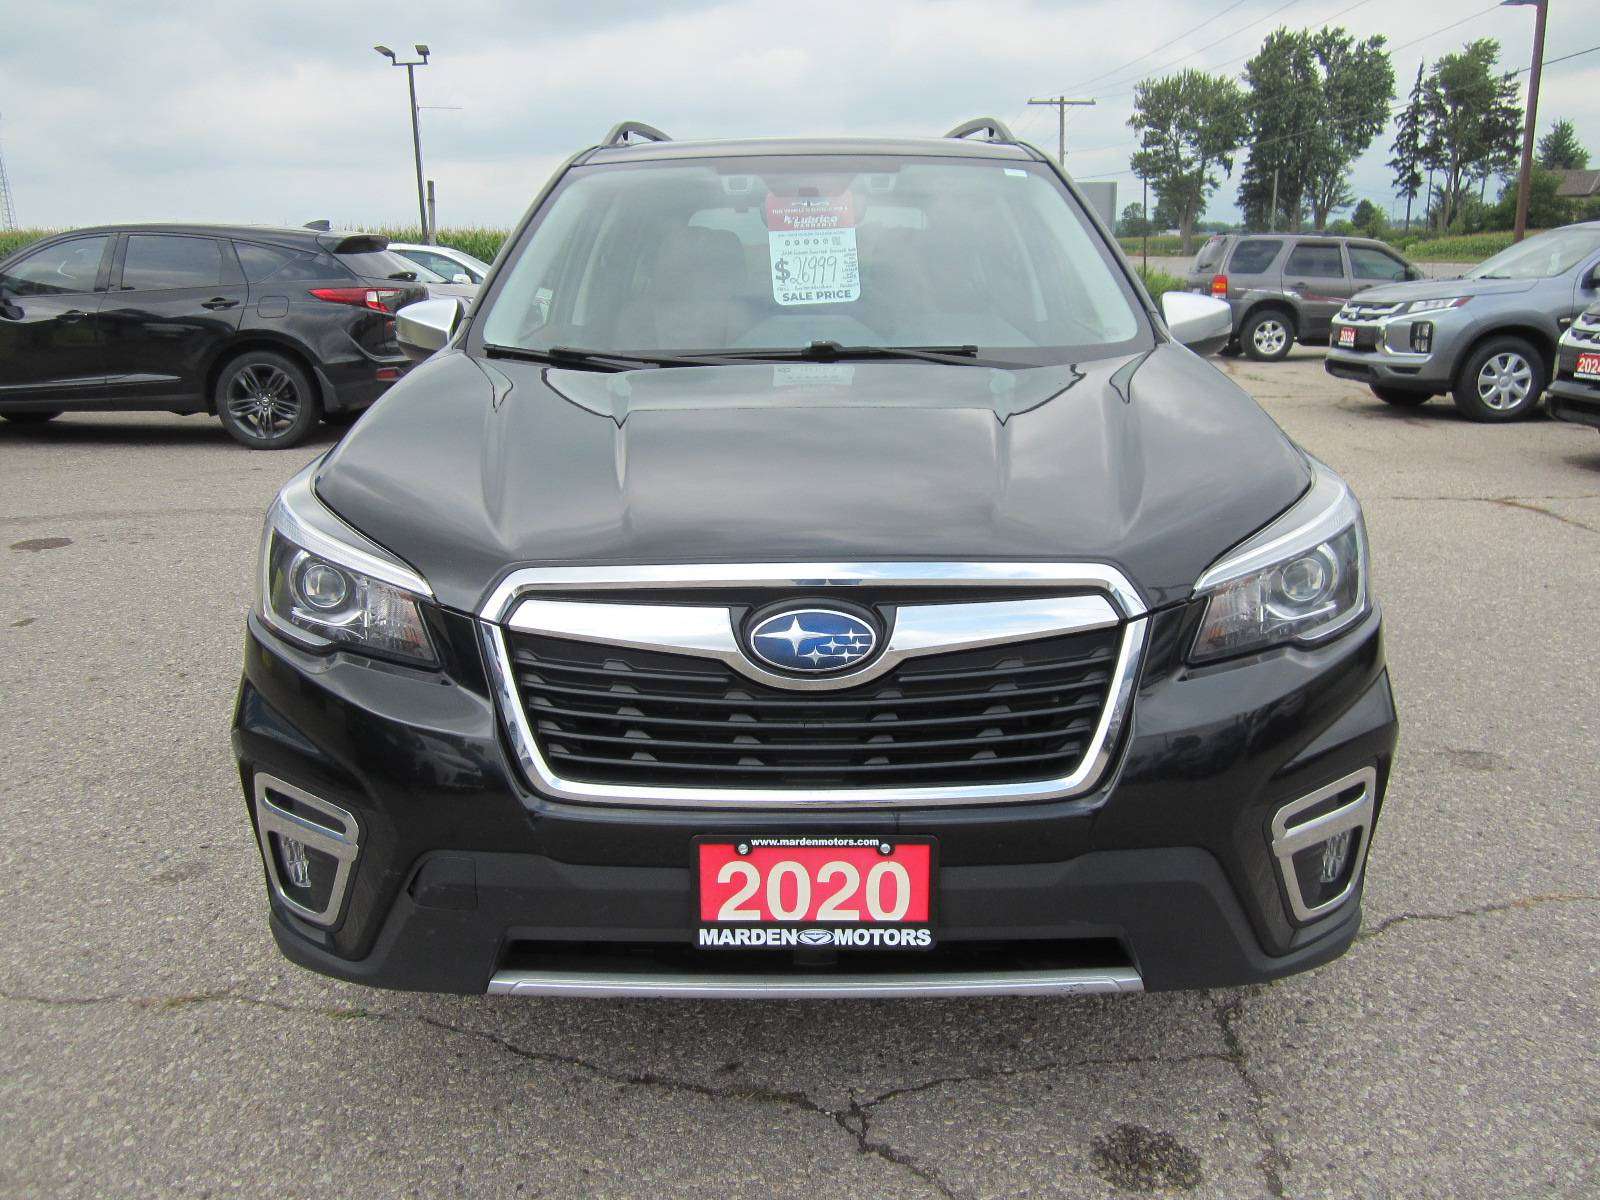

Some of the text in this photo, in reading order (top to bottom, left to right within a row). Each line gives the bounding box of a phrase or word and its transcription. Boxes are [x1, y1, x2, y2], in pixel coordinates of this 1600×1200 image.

[782, 291, 813, 302] SALE
[815, 289, 852, 300] PRICE
[750, 837, 880, 847] www.mardenmotors.com
[717, 860, 911, 921] 2020
[699, 928, 932, 945] MARDEN MOTORS
